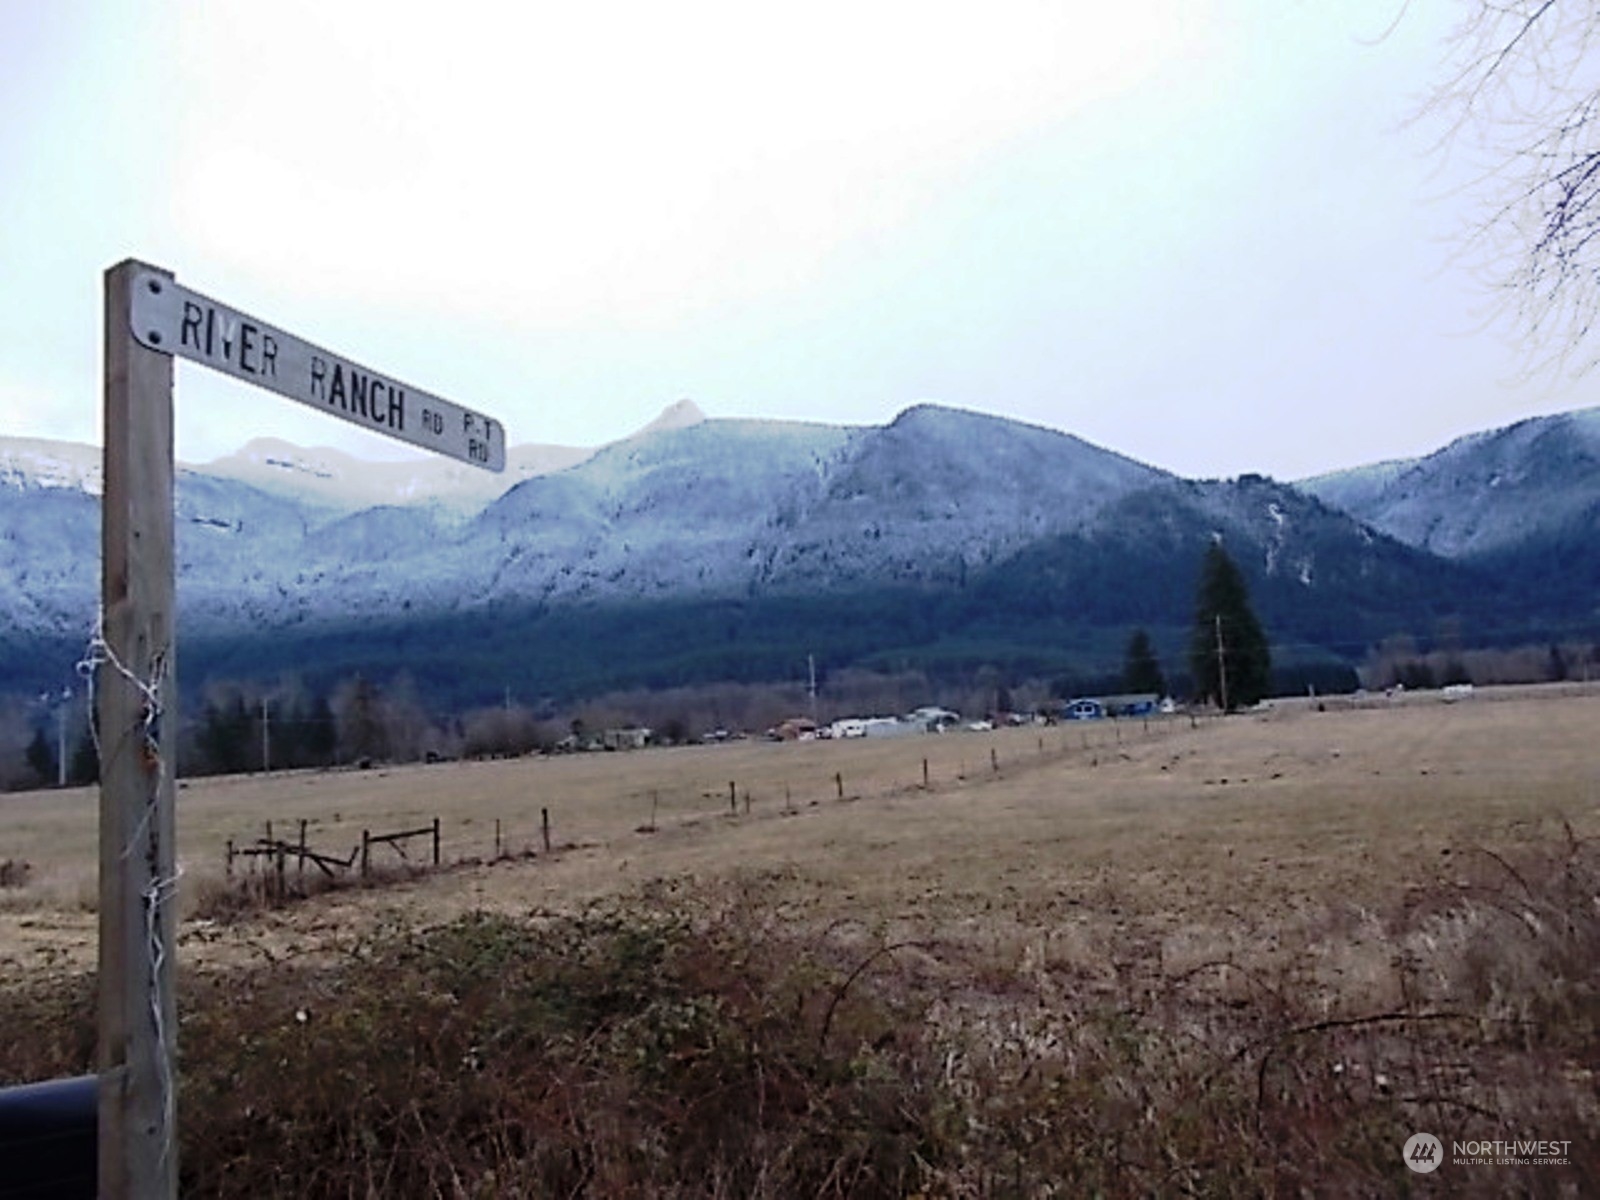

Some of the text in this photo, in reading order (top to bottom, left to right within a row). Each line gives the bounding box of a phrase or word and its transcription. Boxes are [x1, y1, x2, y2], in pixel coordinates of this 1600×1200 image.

[181, 301, 443, 435] RIVER RANCH RD
[469, 438, 488, 462] RD
